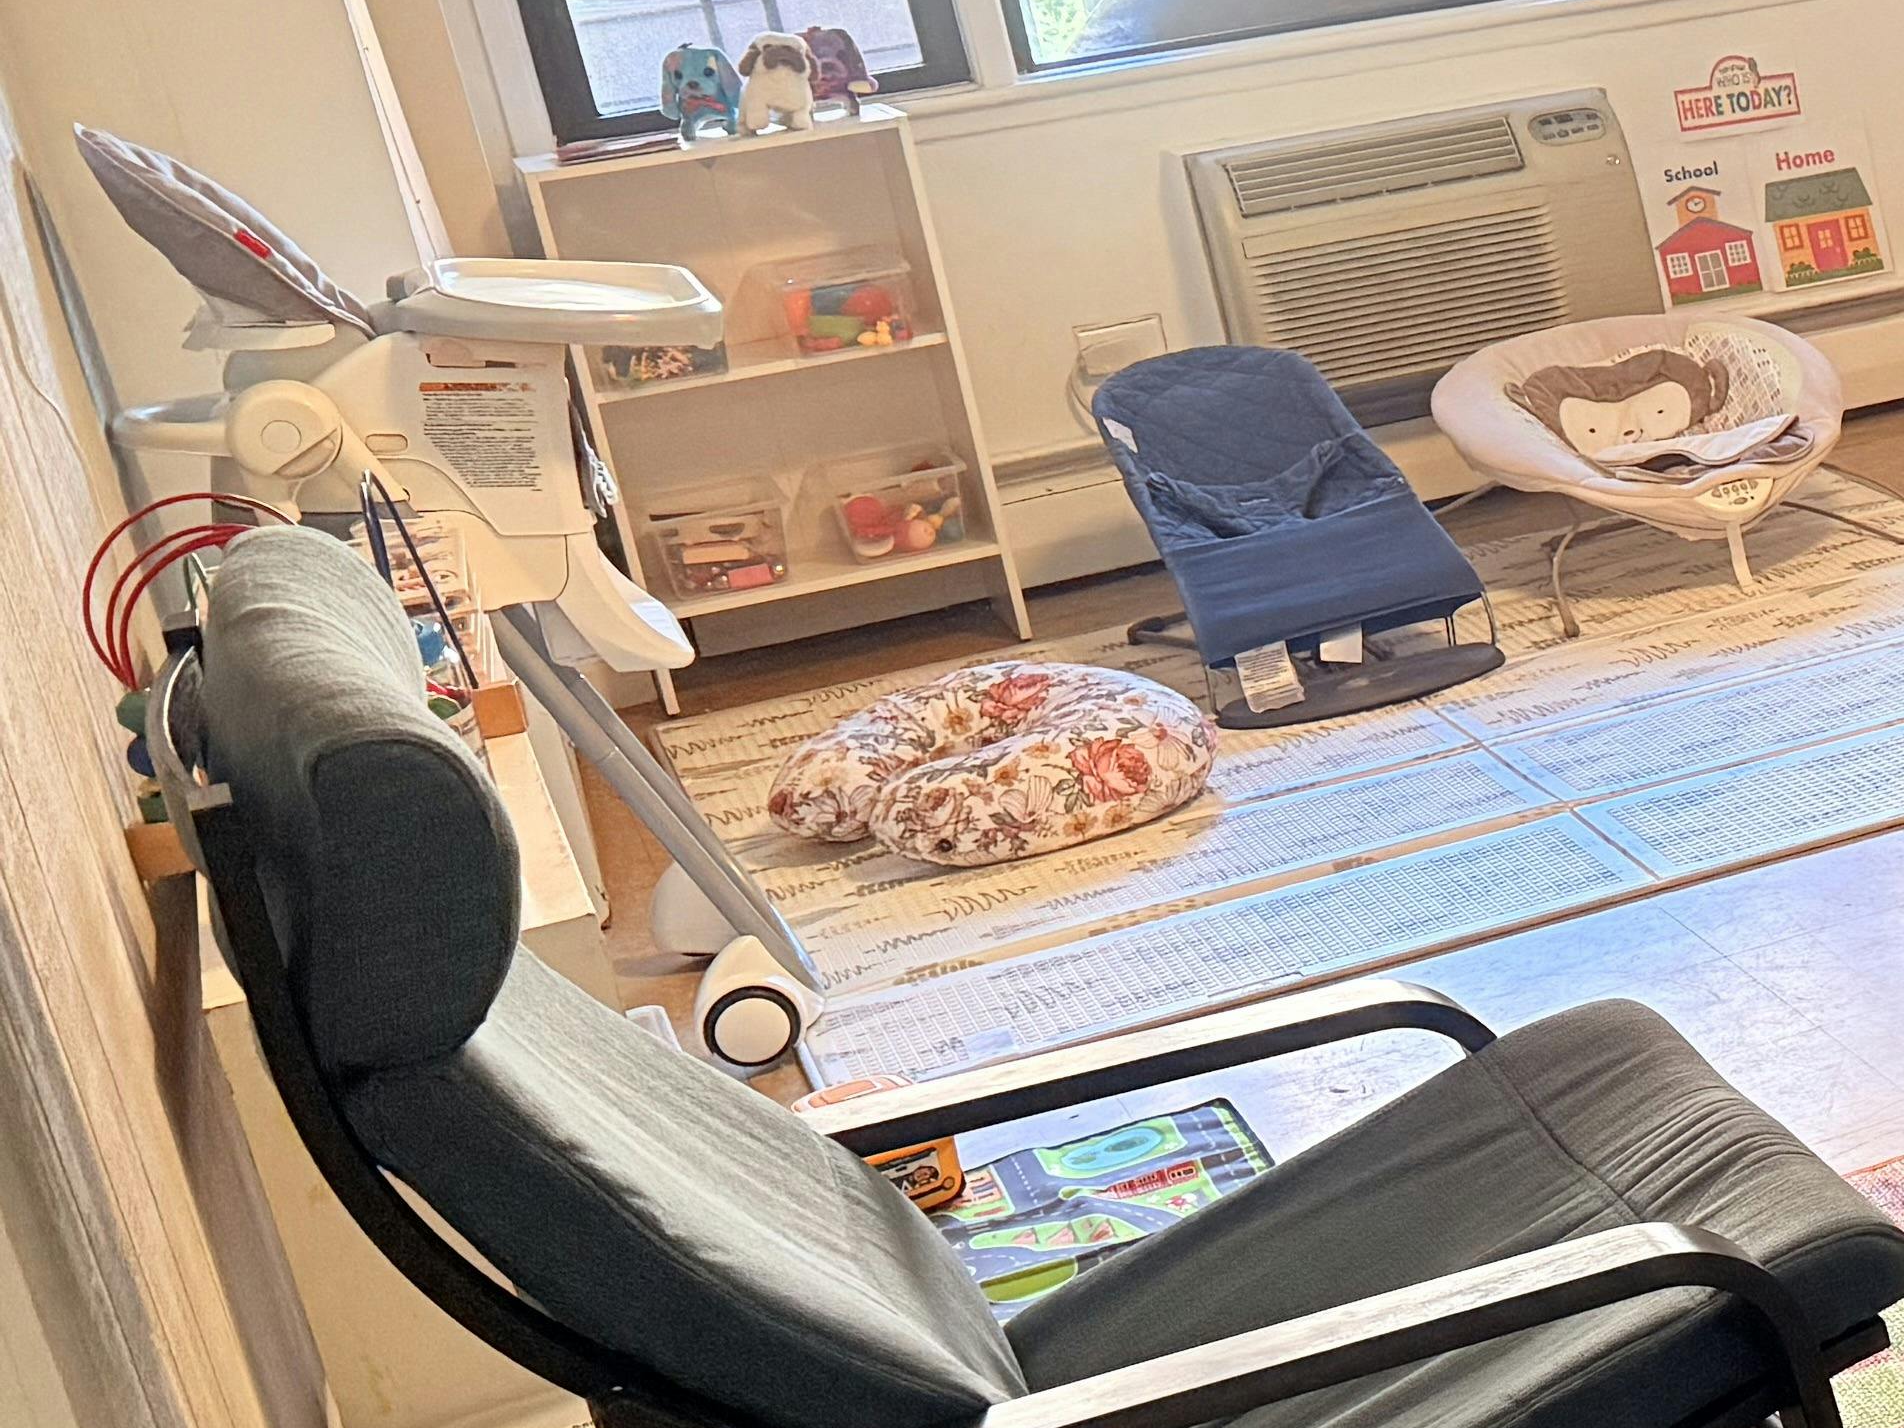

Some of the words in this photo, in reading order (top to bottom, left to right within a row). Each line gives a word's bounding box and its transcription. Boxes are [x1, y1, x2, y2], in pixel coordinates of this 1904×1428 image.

[1681, 94, 1725, 121] HERE
[1726, 84, 1793, 114] TODAY?
[1663, 160, 1719, 183] School
[1776, 149, 1836, 172] Home
